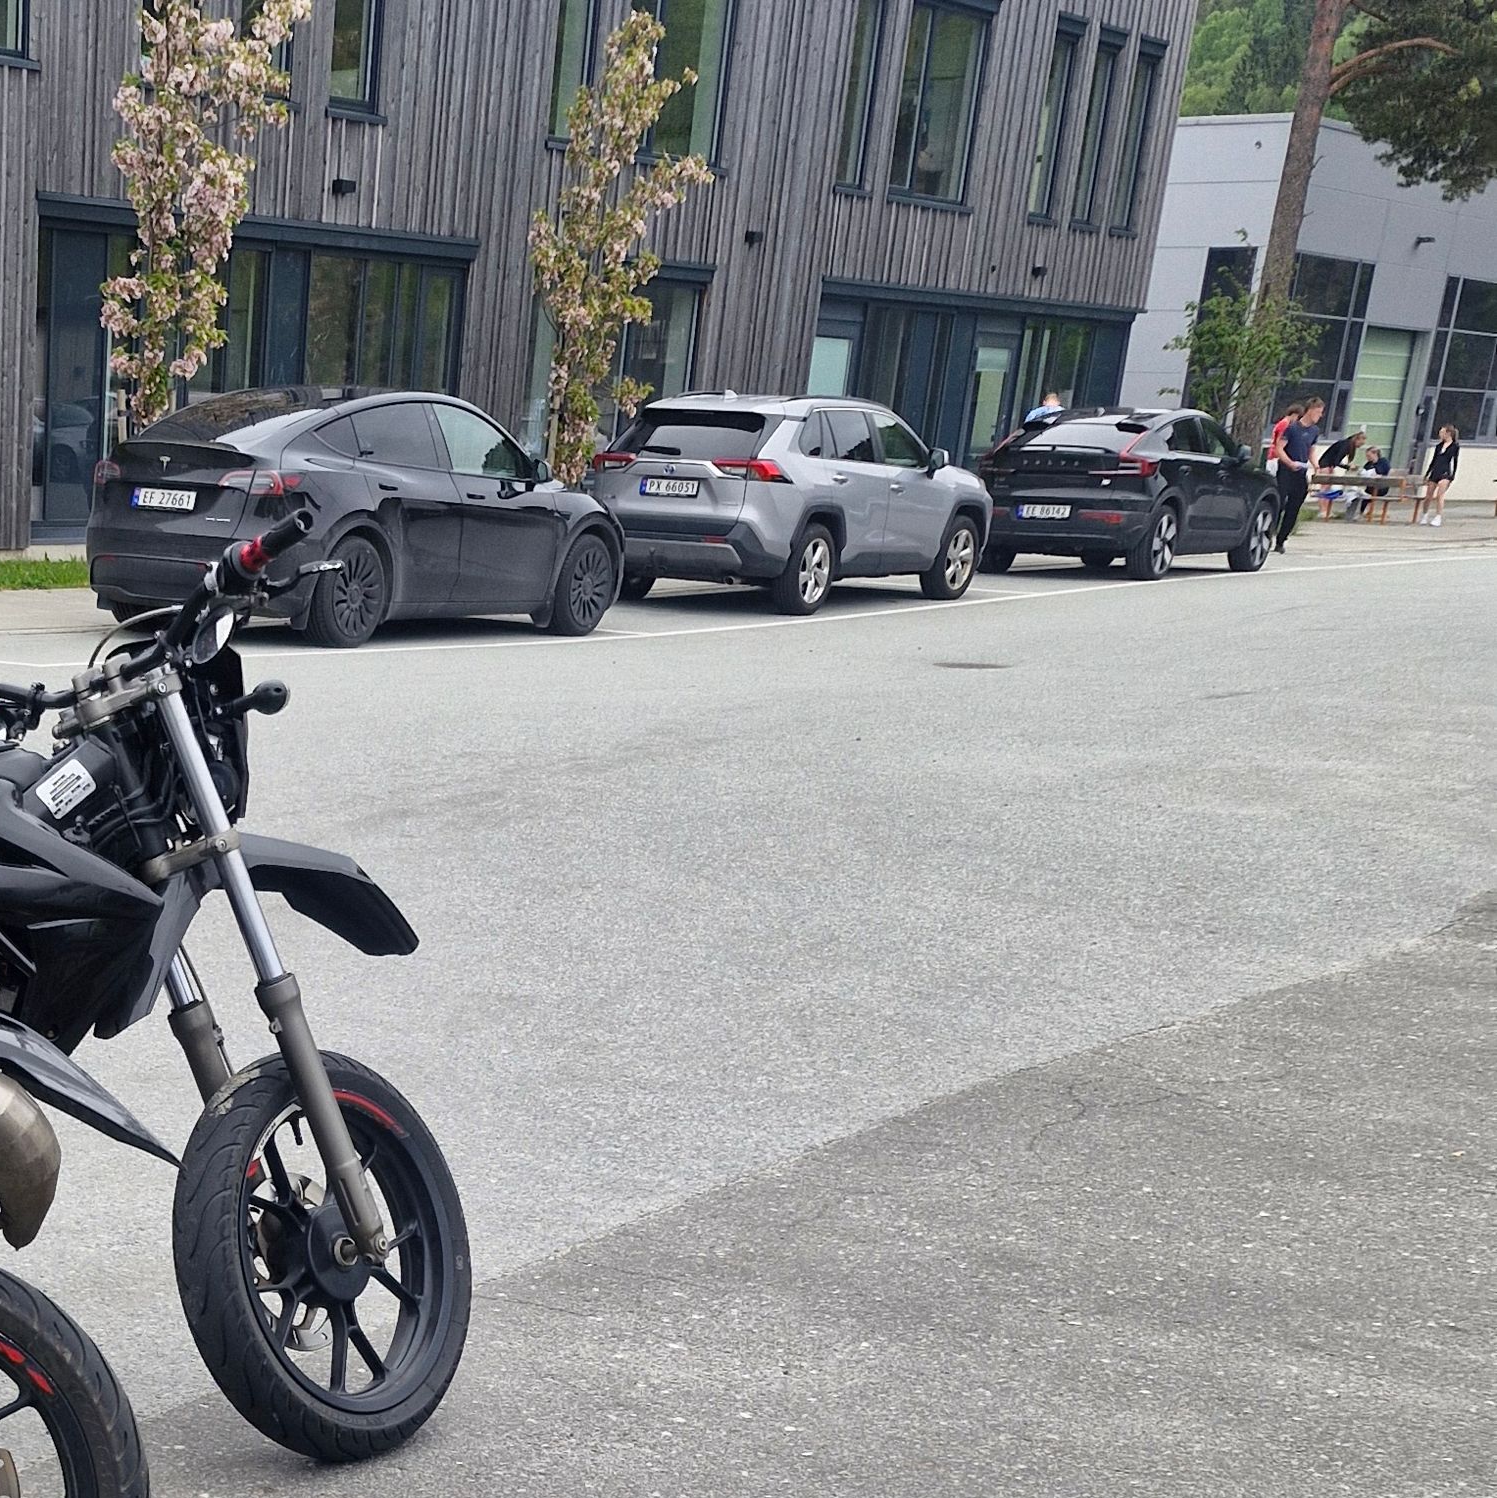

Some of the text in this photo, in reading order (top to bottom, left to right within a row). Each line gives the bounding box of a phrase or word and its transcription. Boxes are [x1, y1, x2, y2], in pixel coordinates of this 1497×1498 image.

[648, 480, 695, 494] PX 66051
[142, 490, 191, 507] EF 27661
